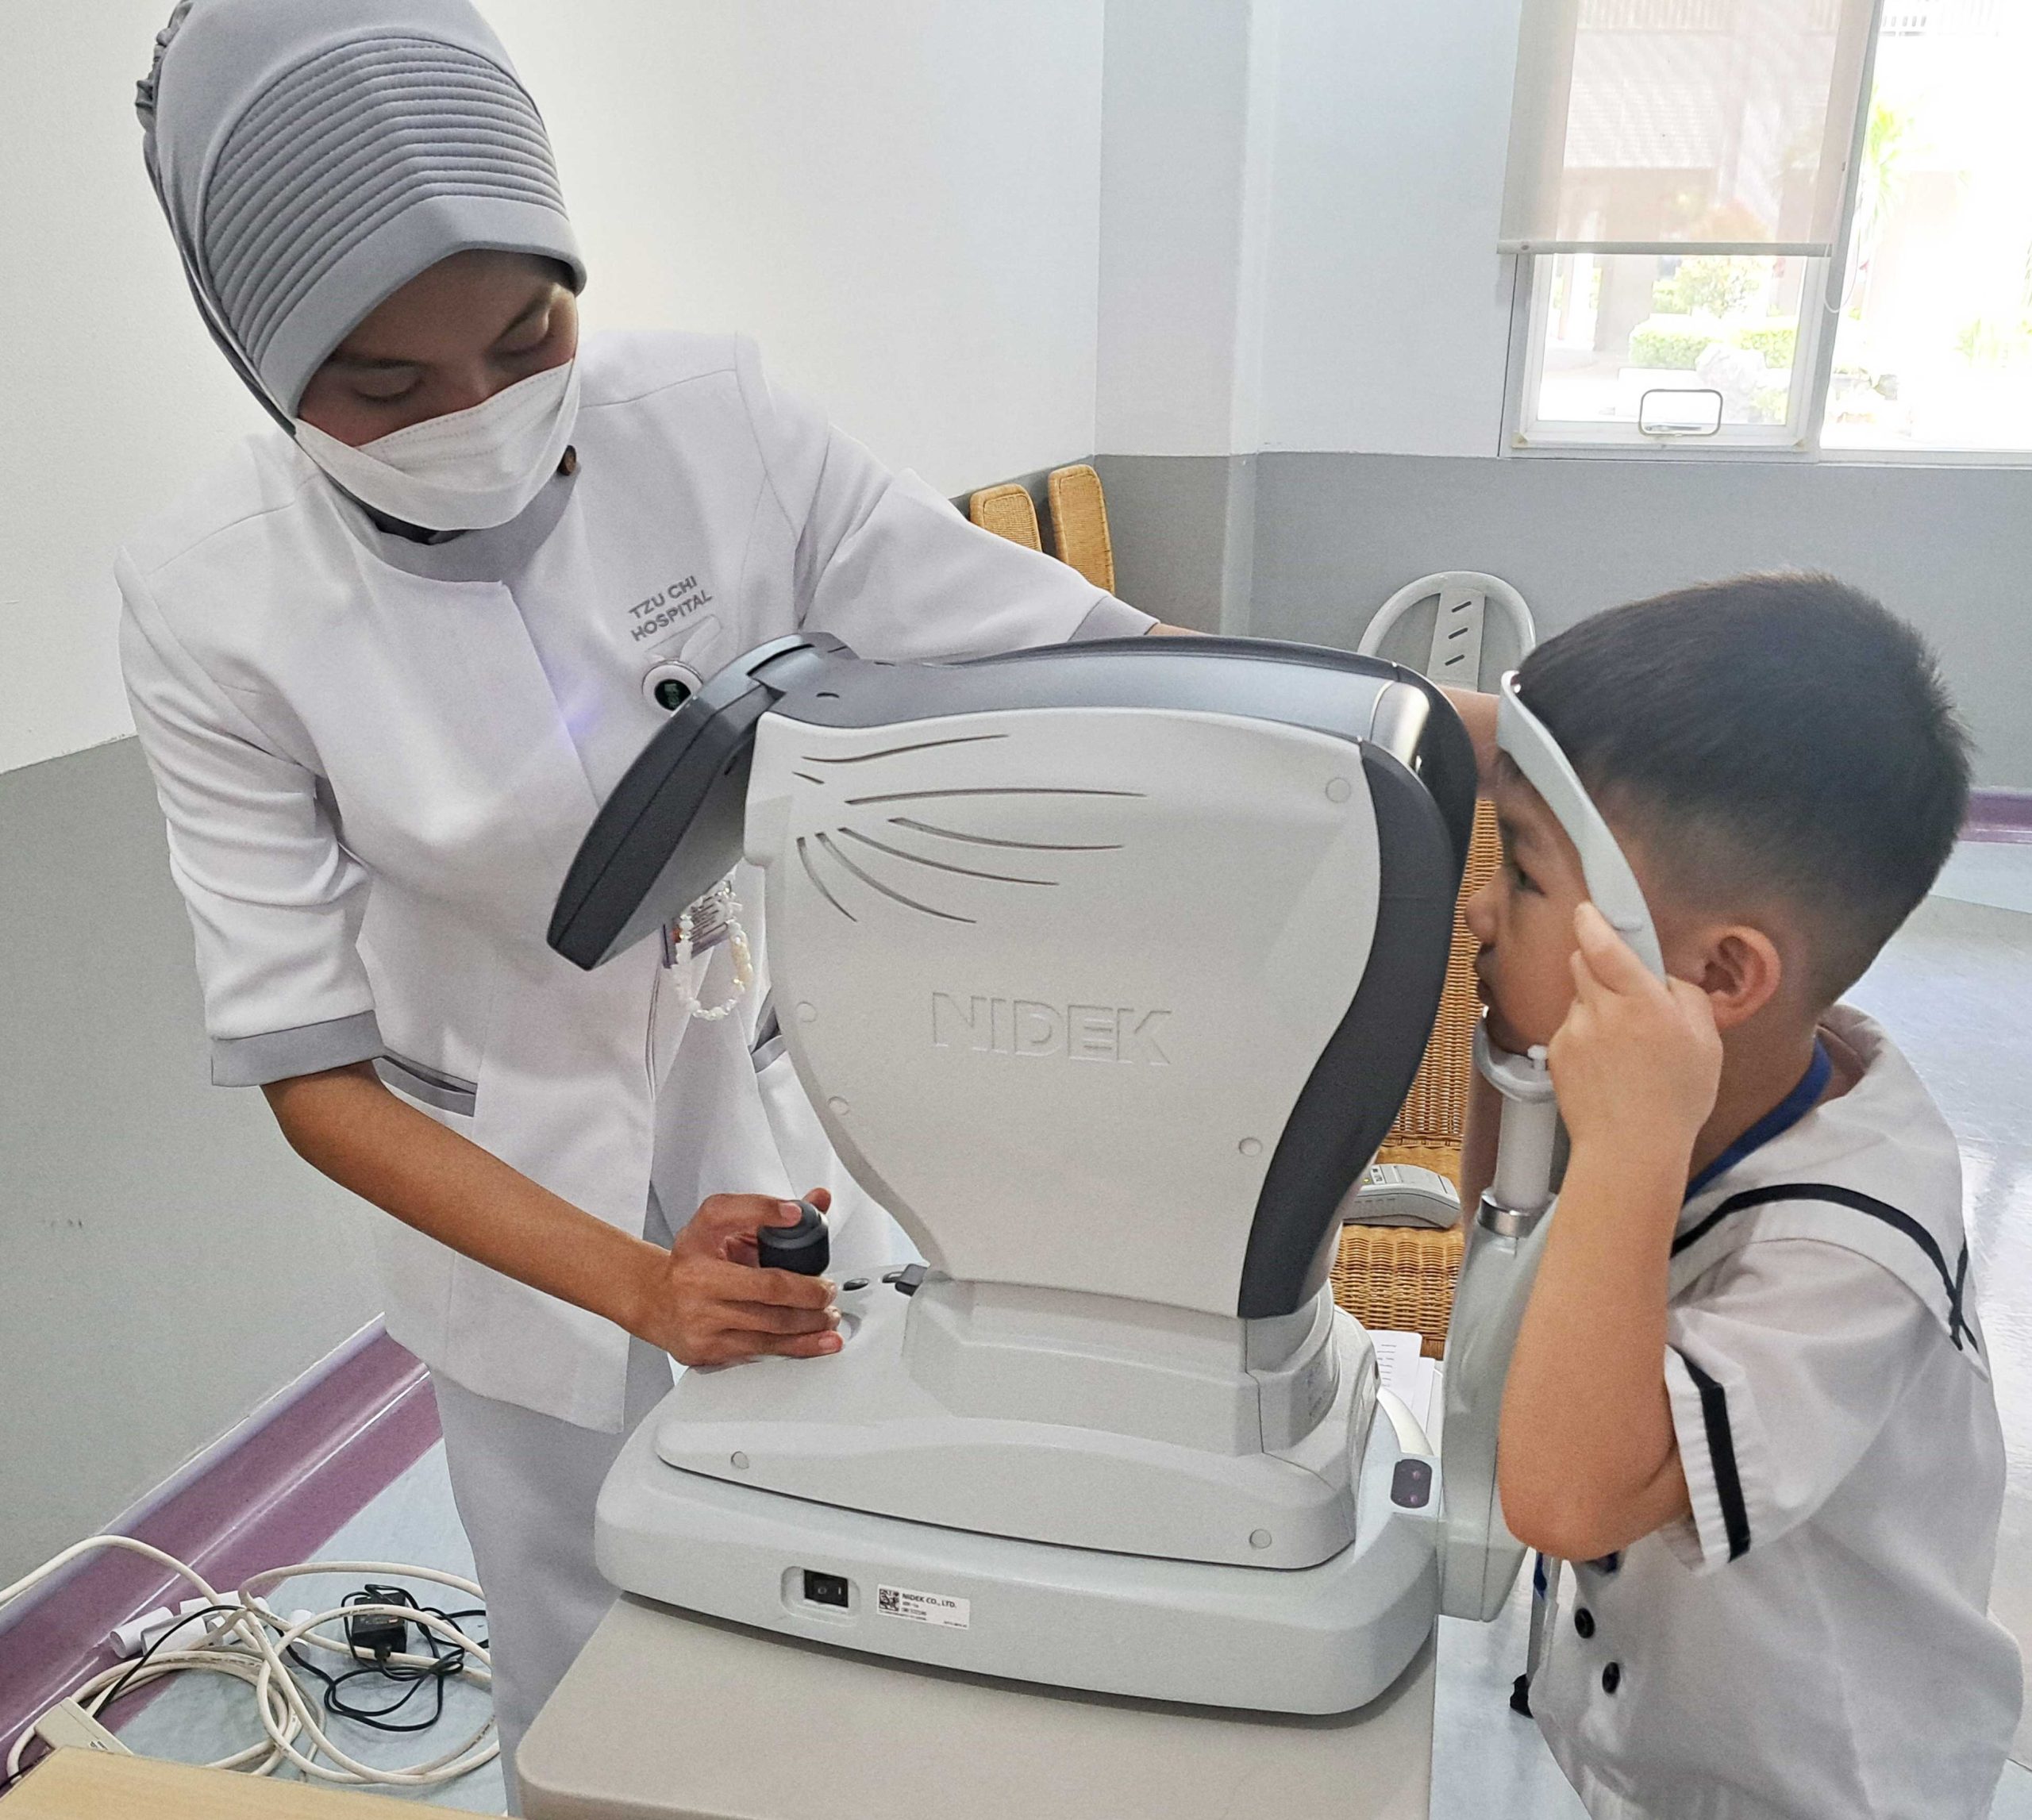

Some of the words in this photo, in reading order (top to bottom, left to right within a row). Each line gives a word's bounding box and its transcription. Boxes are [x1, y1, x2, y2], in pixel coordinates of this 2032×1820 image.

[629, 593, 665, 618] TZU
[668, 575, 697, 598] CHI
[630, 590, 713, 641] HOSPITAL
[932, 992, 1172, 1065] NIDEK
[902, 1593, 926, 1603] NIDEK
[941, 1599, 957, 1608] LTD.
